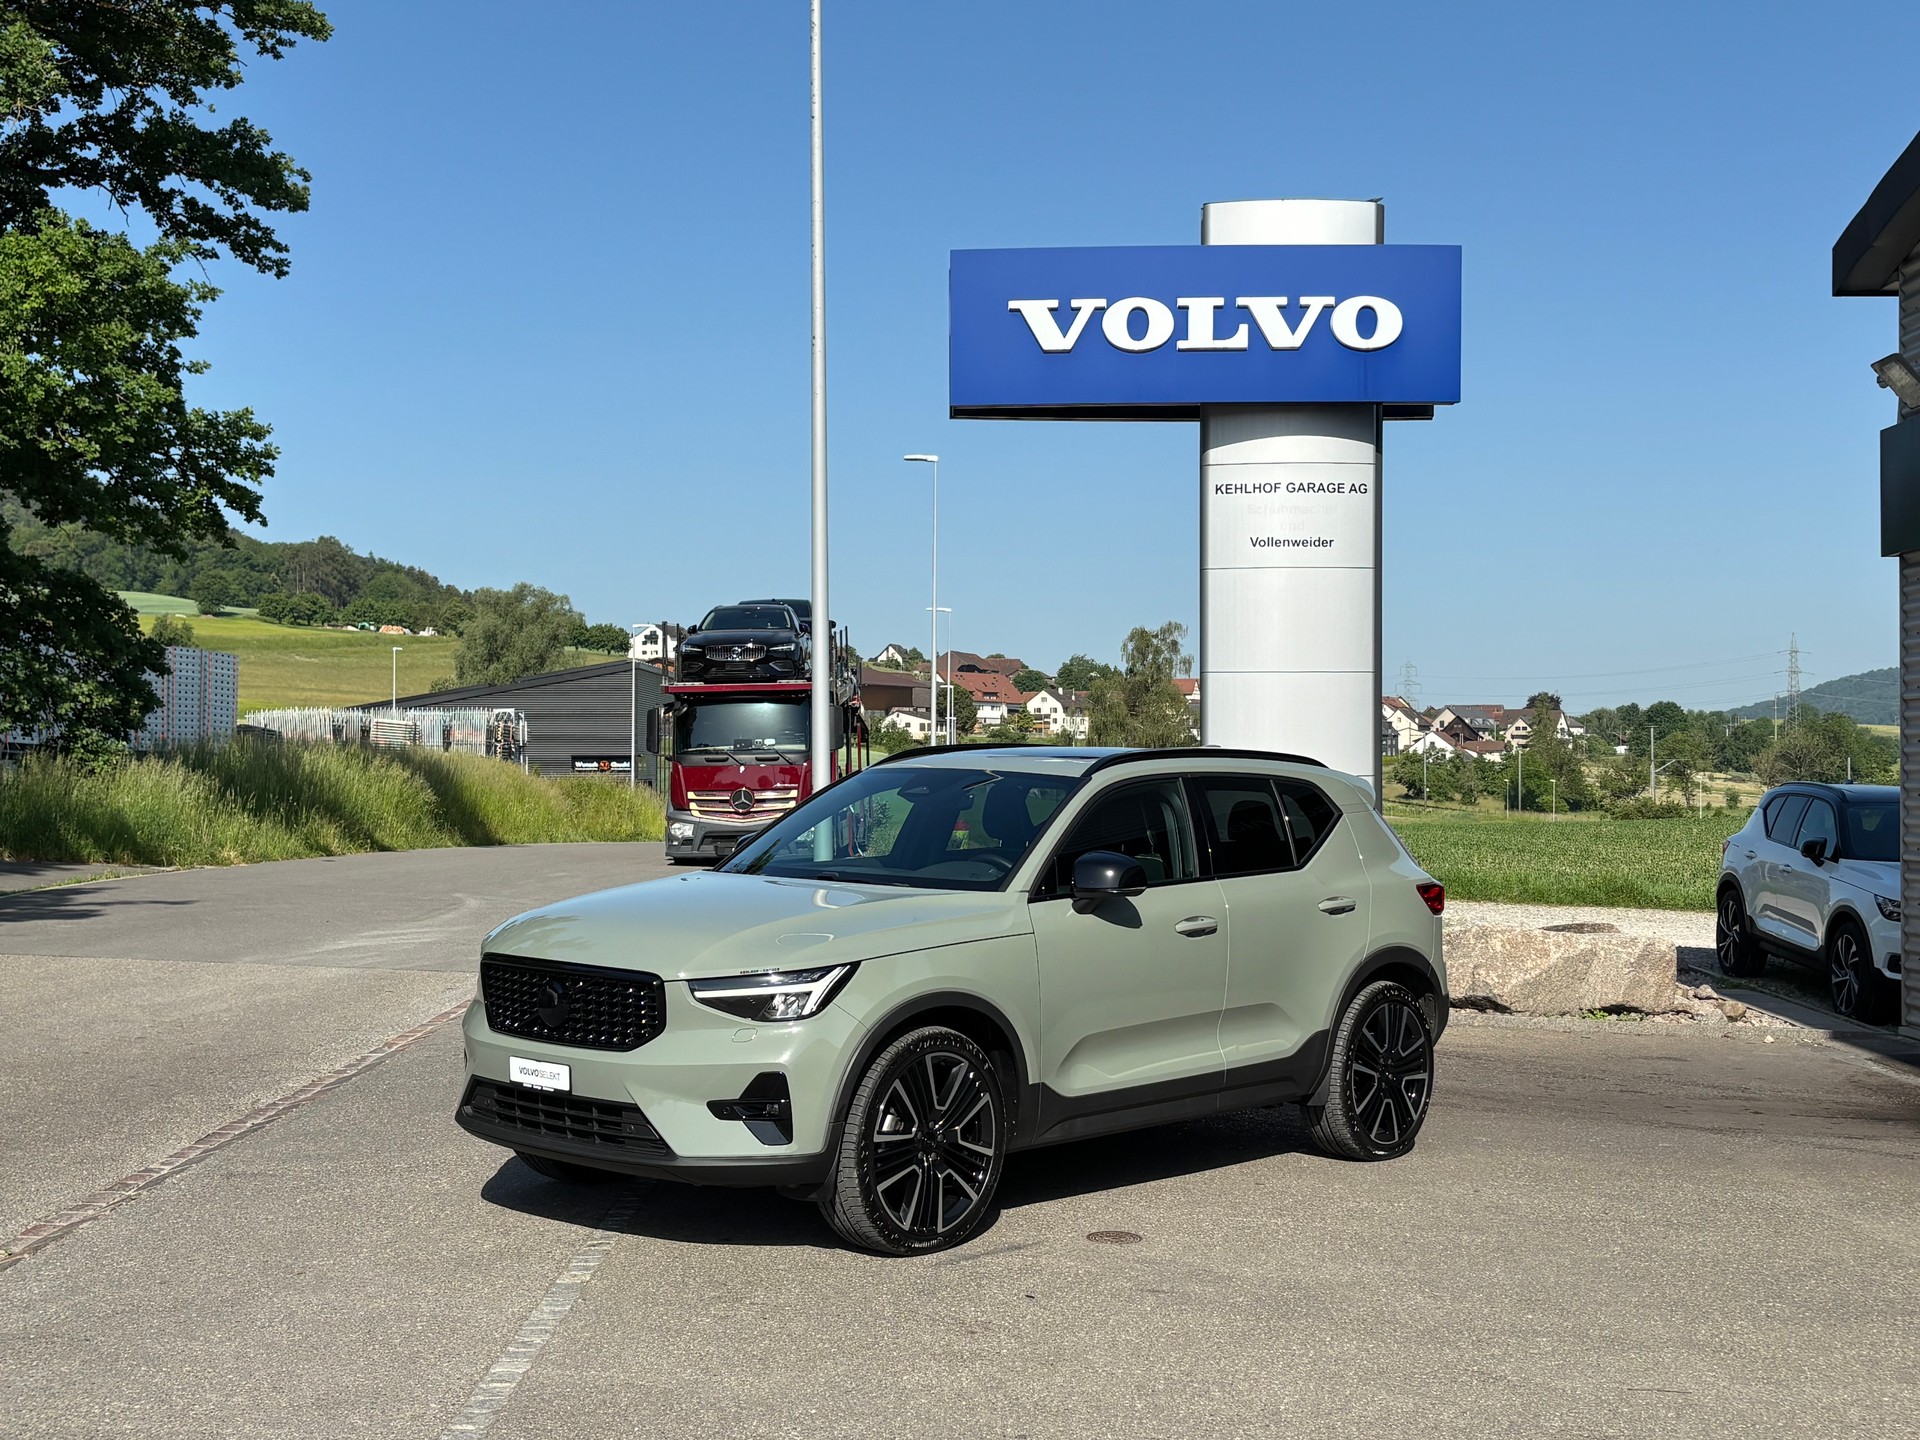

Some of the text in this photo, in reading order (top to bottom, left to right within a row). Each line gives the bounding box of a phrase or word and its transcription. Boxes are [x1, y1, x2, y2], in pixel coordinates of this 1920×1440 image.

[1008, 295, 1403, 353] VOLVO
[1215, 482, 1368, 495] KEHLHOF GARAGE AG
[1250, 536, 1335, 548] Vollenweider
